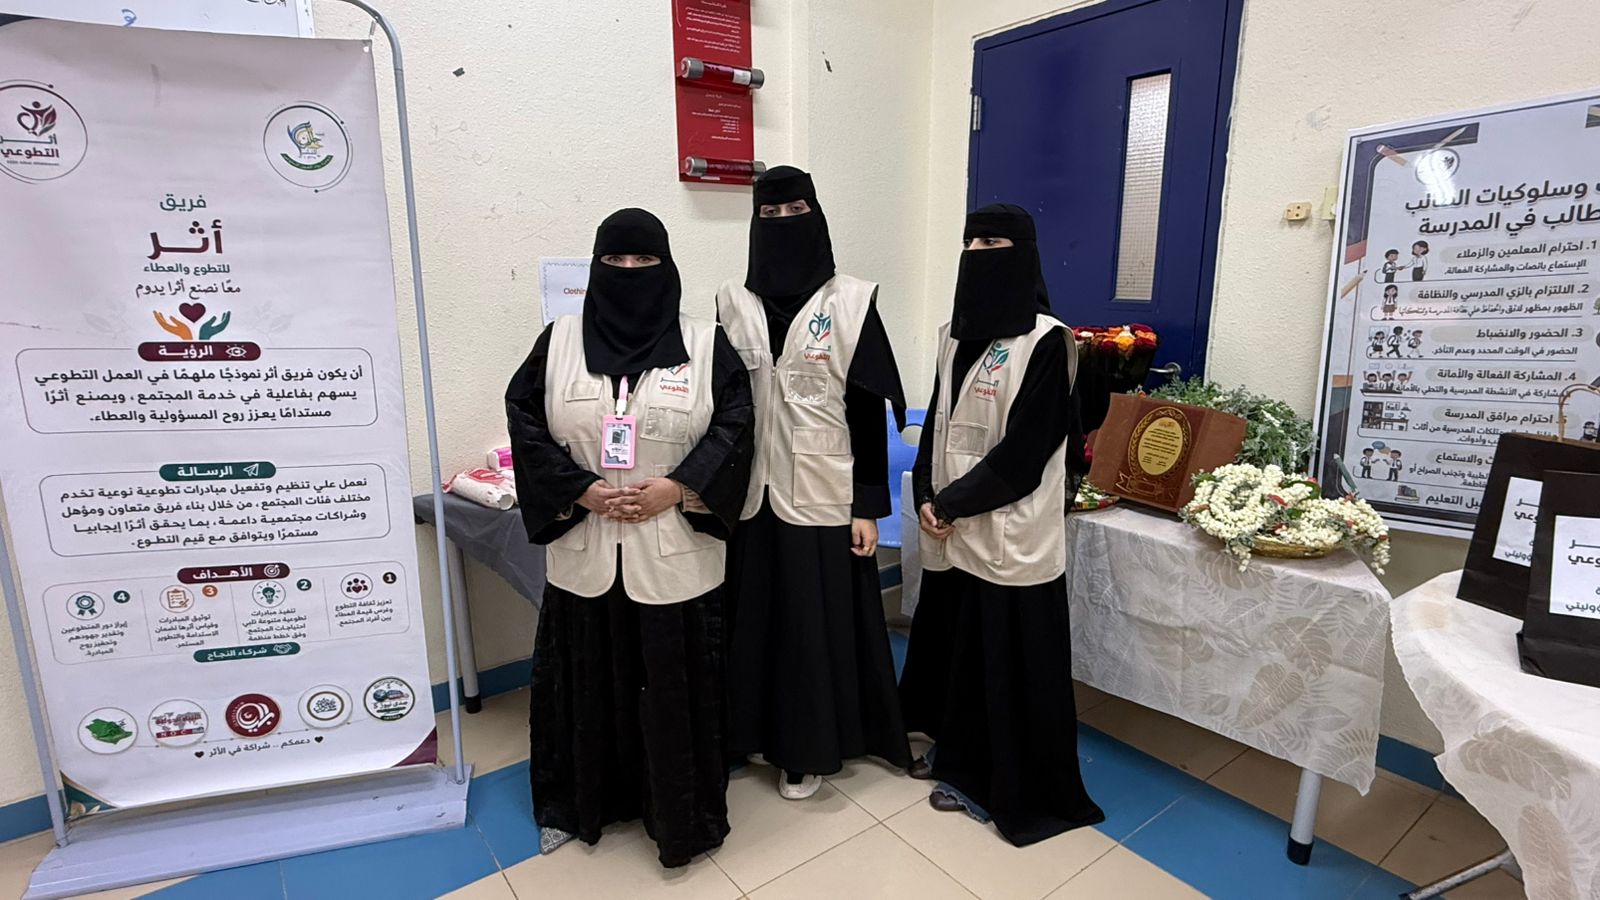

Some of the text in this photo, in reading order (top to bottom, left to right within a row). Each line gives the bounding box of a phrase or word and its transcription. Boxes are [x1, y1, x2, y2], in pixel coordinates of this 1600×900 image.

[0, 147, 60, 159] التطوعي
[1476, 180, 1588, 203] وسلوكيات
[159, 193, 207, 212] فريق
[1419, 204, 1600, 236] طالب في المدرسة
[147, 219, 223, 260] أثر
[1457, 248, 1494, 259] والزملاء
[1498, 244, 1546, 258] المعلمين
[1548, 241, 1583, 256] احترام
[143, 263, 230, 276] للتطوع والعطاء
[1474, 264, 1515, 274] والمشاركة
[135, 283, 165, 298] يدوم
[189, 283, 219, 300] نصنع
[1417, 289, 1458, 300] والنظافة
[1461, 288, 1503, 302] المدرسي
[1506, 286, 1532, 300] بالزي
[1535, 284, 1574, 298] الالتزام
[1525, 304, 1550, 313] بمظهر
[1553, 303, 1583, 312] الظهور
[1476, 328, 1568, 340] الحضور والانضباط
[158, 345, 213, 359] الرؤية
[1455, 346, 1577, 357] الحضور في الوقت المحدد وعدم
[34, 369, 98, 386] التطوعي
[102, 369, 143, 383] العمل
[147, 369, 170, 385] في
[220, 367, 261, 382] نموذجًا
[264, 366, 278, 381] أثر
[281, 368, 313, 381] فريق
[317, 367, 347, 381] يكون
[350, 365, 363, 380] أن
[1437, 368, 1474, 380] والأمانة
[1476, 370, 1510, 380] الفعالة
[1513, 371, 1562, 382] المشاركة
[198, 389, 236, 400] خدمة
[240, 389, 261, 404] في
[266, 388, 313, 401] بفاعلية
[317, 390, 357, 402] يسهم
[1449, 386, 1484, 396] المدرسية
[1485, 387, 1517, 398] الأنشطة
[1518, 389, 1531, 399] في
[76, 391, 126, 405] ويصنع
[89, 407, 332, 423] مستدامًا يعزز روح المسؤولية والعطاء.
[1445, 409, 1484, 420] المدرسة
[1486, 413, 1518, 423] مرافق
[1520, 413, 1553, 425] احترام
[1442, 426, 1475, 434] المدرسية
[1435, 452, 1483, 466] والاستماع
[177, 465, 233, 478] الرسالة
[1417, 466, 1441, 476] الصراخ
[1442, 469, 1466, 479] وتجنب
[60, 478, 367, 502] نعمل تنظيم وتفعيل مبادرات تطوعية نوعية تخدم
[1426, 493, 1463, 505] التعليم
[61, 494, 371, 518] مختلف فئات من خلال بناء فريق متعاون ومؤهل
[260, 513, 312, 524] مجتمعية
[315, 510, 367, 520] وشراكات
[150, 519, 186, 531] يحقق
[188, 518, 210, 527] بما
[131, 535, 179, 549] التطوع.
[182, 534, 205, 546] قيم
[208, 536, 226, 546] مع
[229, 531, 275, 543] ويتوافق
[192, 567, 253, 580] الأهداف
[387, 574, 392, 582] 1
[206, 587, 213, 595] 3
[301, 581, 308, 589] 2
[118, 593, 127, 601] 4
[377, 599, 392, 607] تعزيز
[335, 602, 357, 611] التطوع
[159, 615, 189, 623] المبادرات
[366, 615, 379, 623] أفراد
[275, 623, 305, 631] احتياجات
[102, 630, 124, 638] وتقدير
[158, 631, 218, 641] الاستدامة والتطوير
[80, 639, 117, 650] وتحفيز روح
[207, 647, 267, 661] شركاء النجاح
[209, 738, 311, 757] دعمكم شراكة في الأثر
